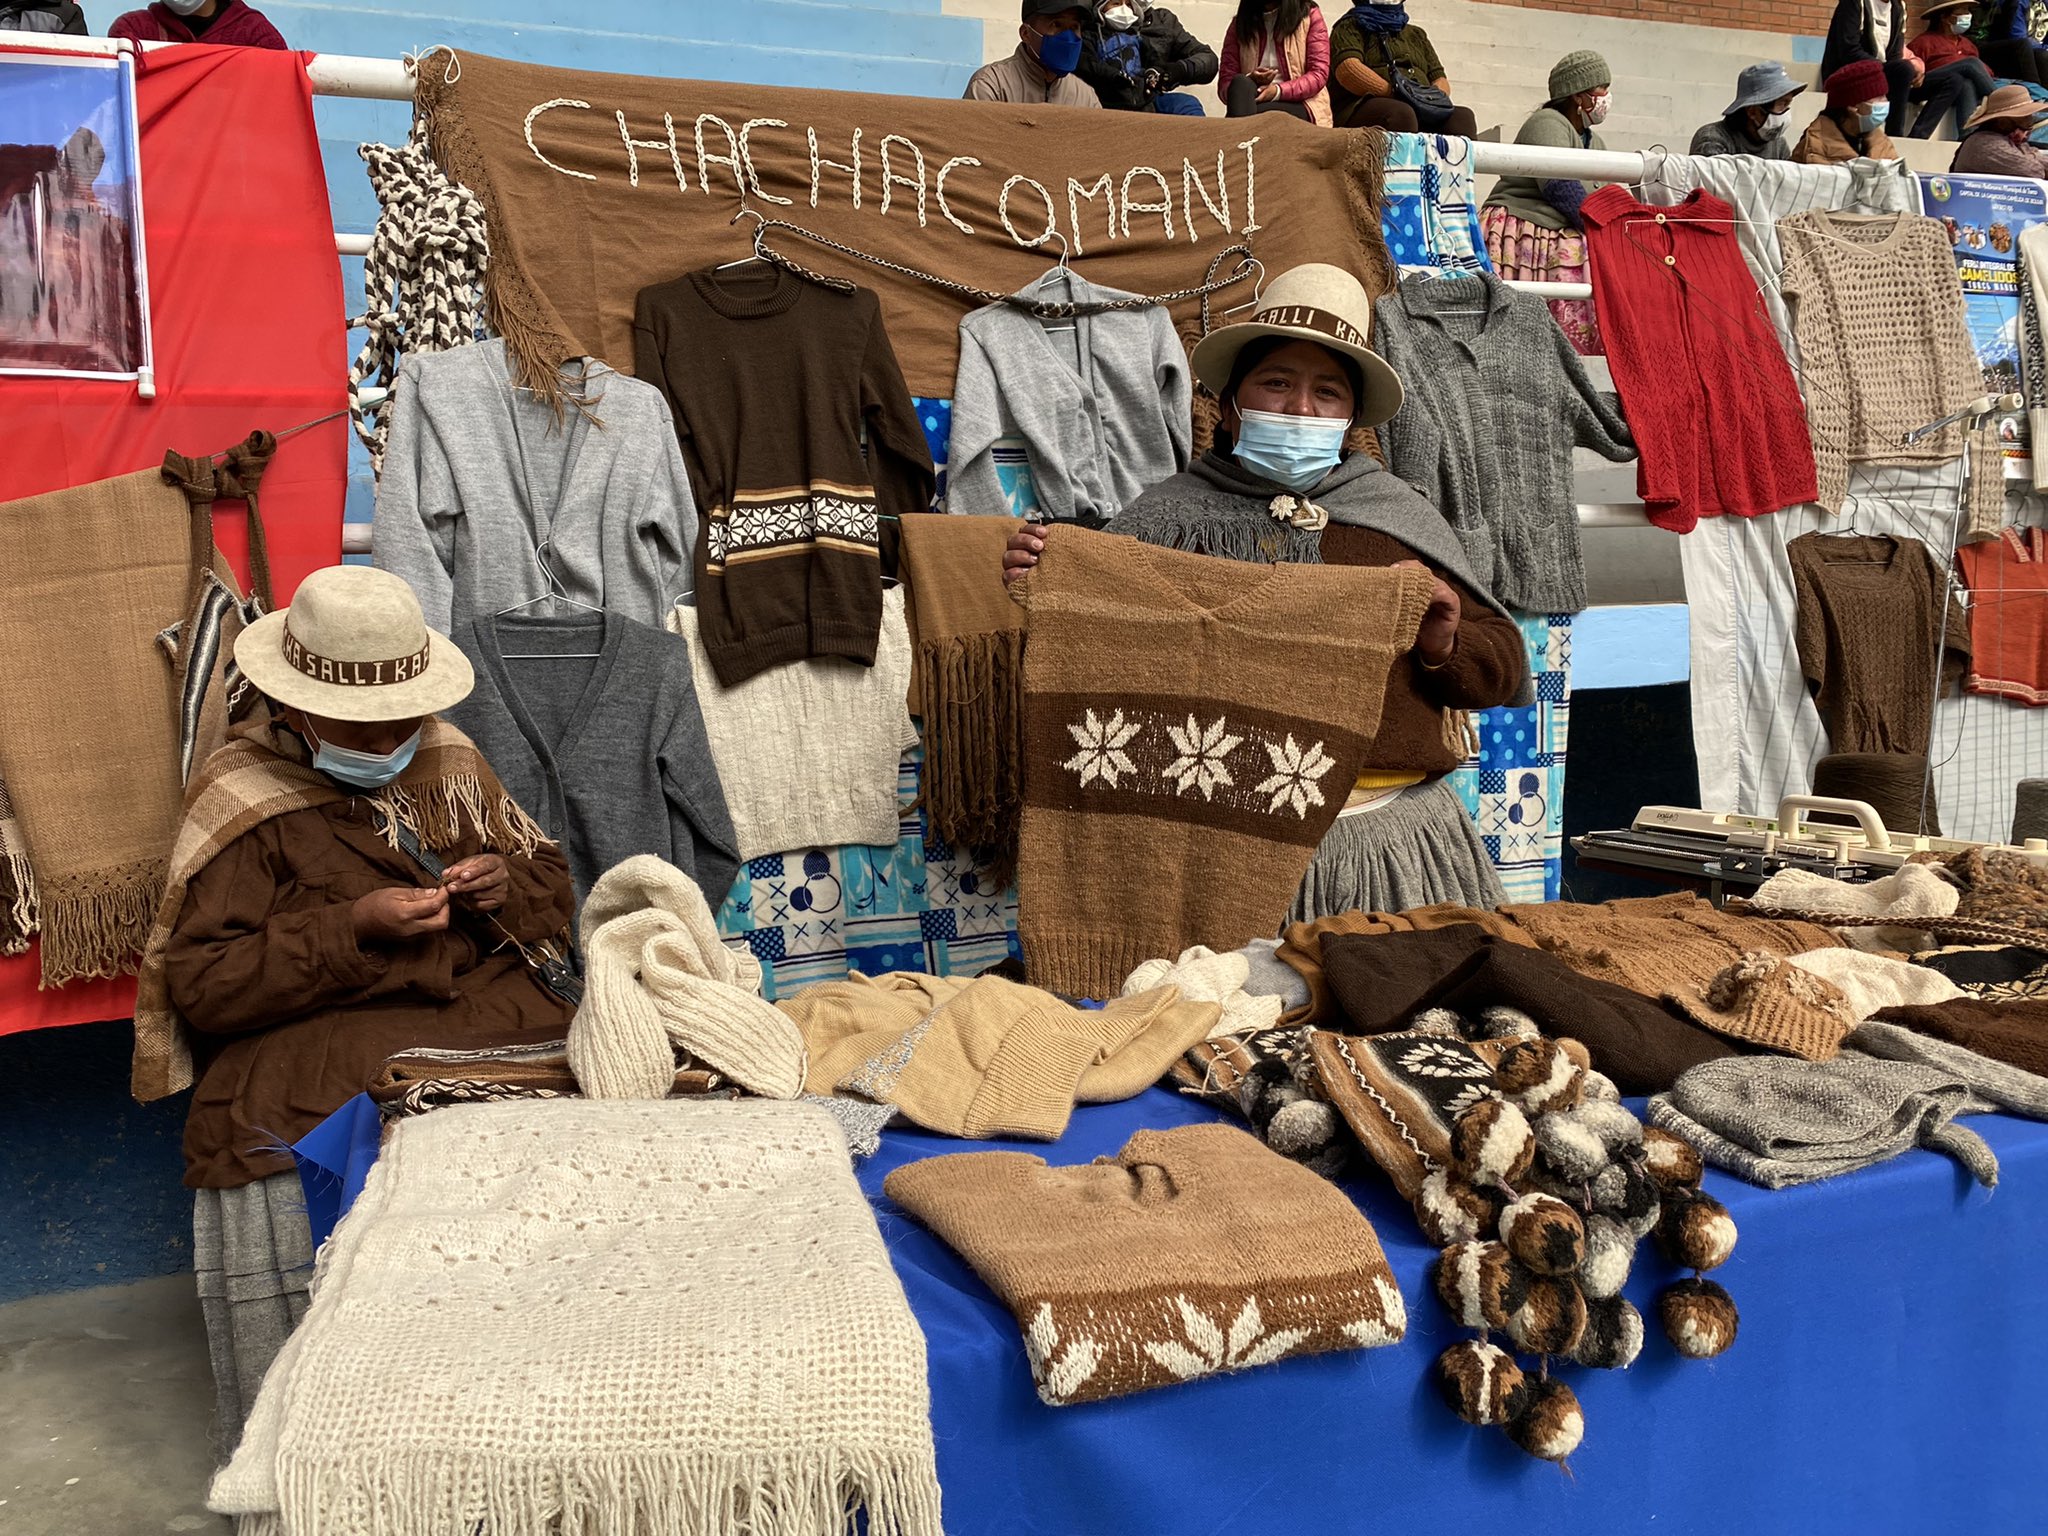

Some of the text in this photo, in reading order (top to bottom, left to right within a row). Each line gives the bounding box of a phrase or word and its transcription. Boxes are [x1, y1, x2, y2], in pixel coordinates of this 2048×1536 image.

[524, 98, 1261, 255] CHACHACOMANI
[1258, 307, 1315, 326] SALLI
[306, 654, 383, 685] SALLI
